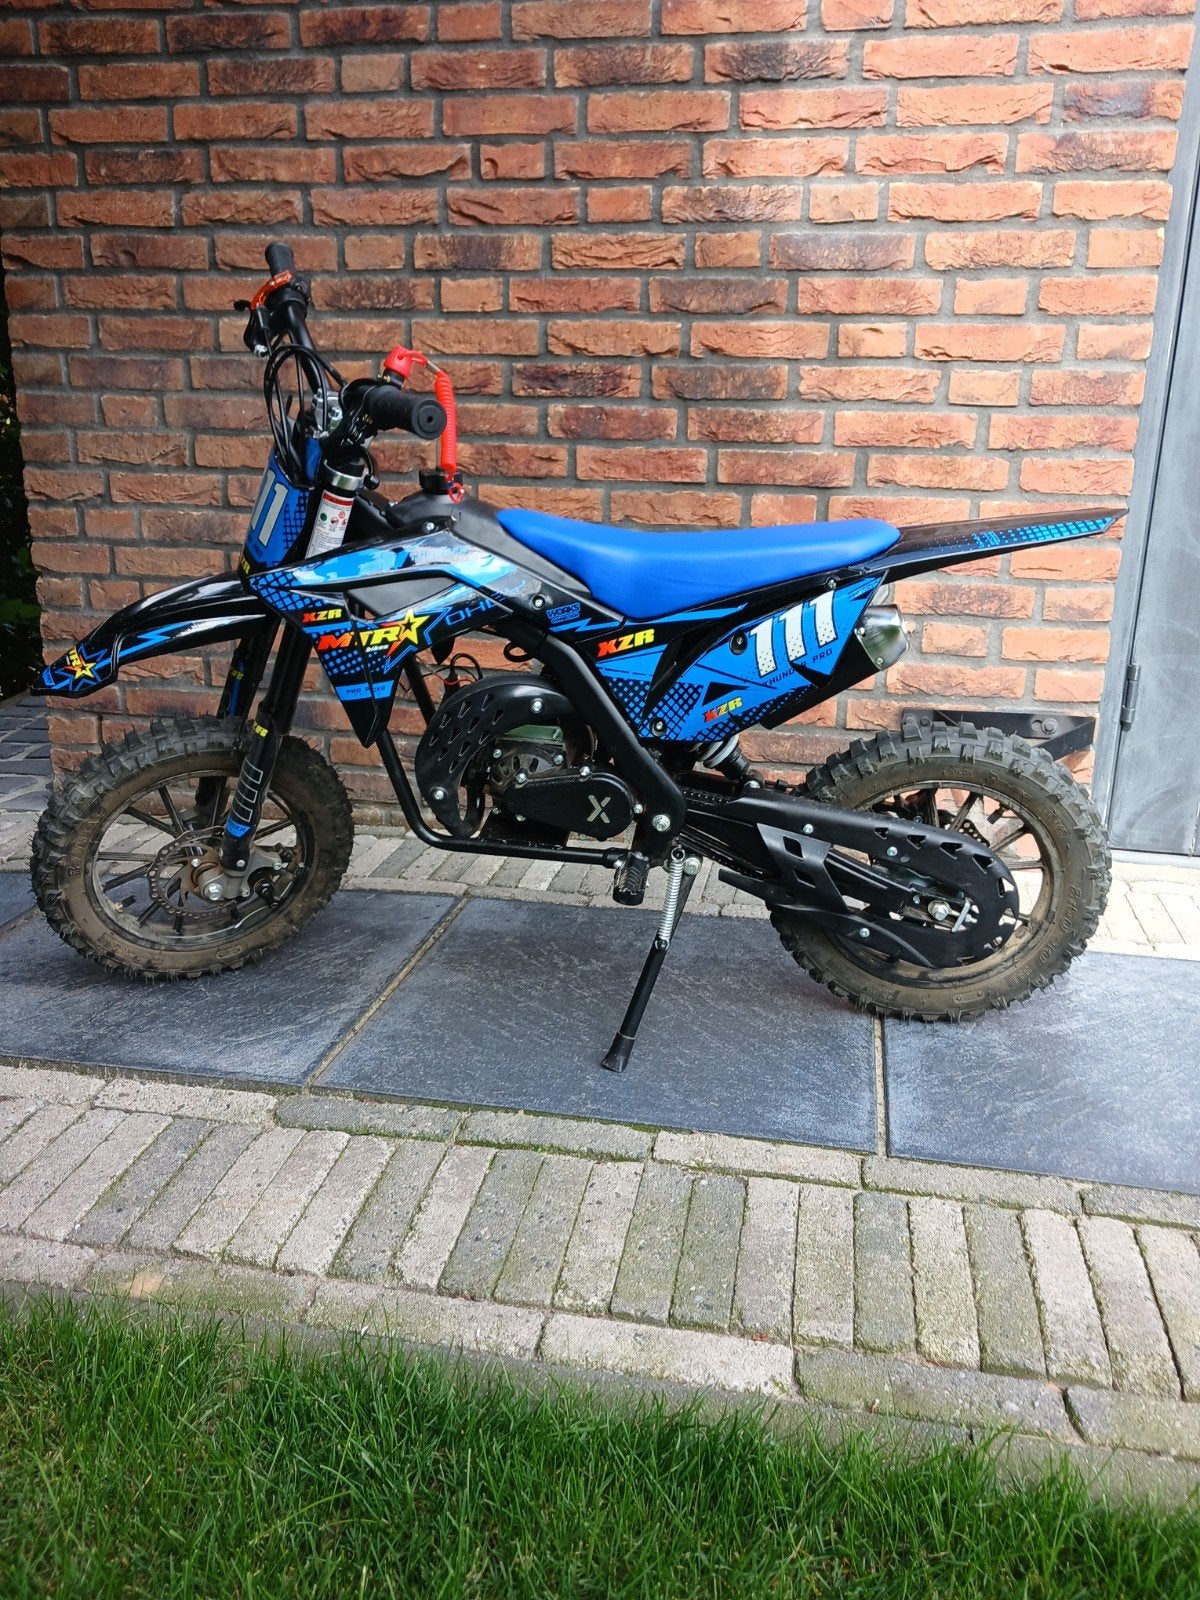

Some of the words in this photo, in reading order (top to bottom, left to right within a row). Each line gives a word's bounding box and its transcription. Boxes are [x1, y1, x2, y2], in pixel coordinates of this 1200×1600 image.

[302, 608, 343, 623] XZR
[597, 628, 655, 657] XZR
[749, 590, 838, 678] 111
[812, 647, 833, 663] PRO
[703, 697, 743, 723] XZR
